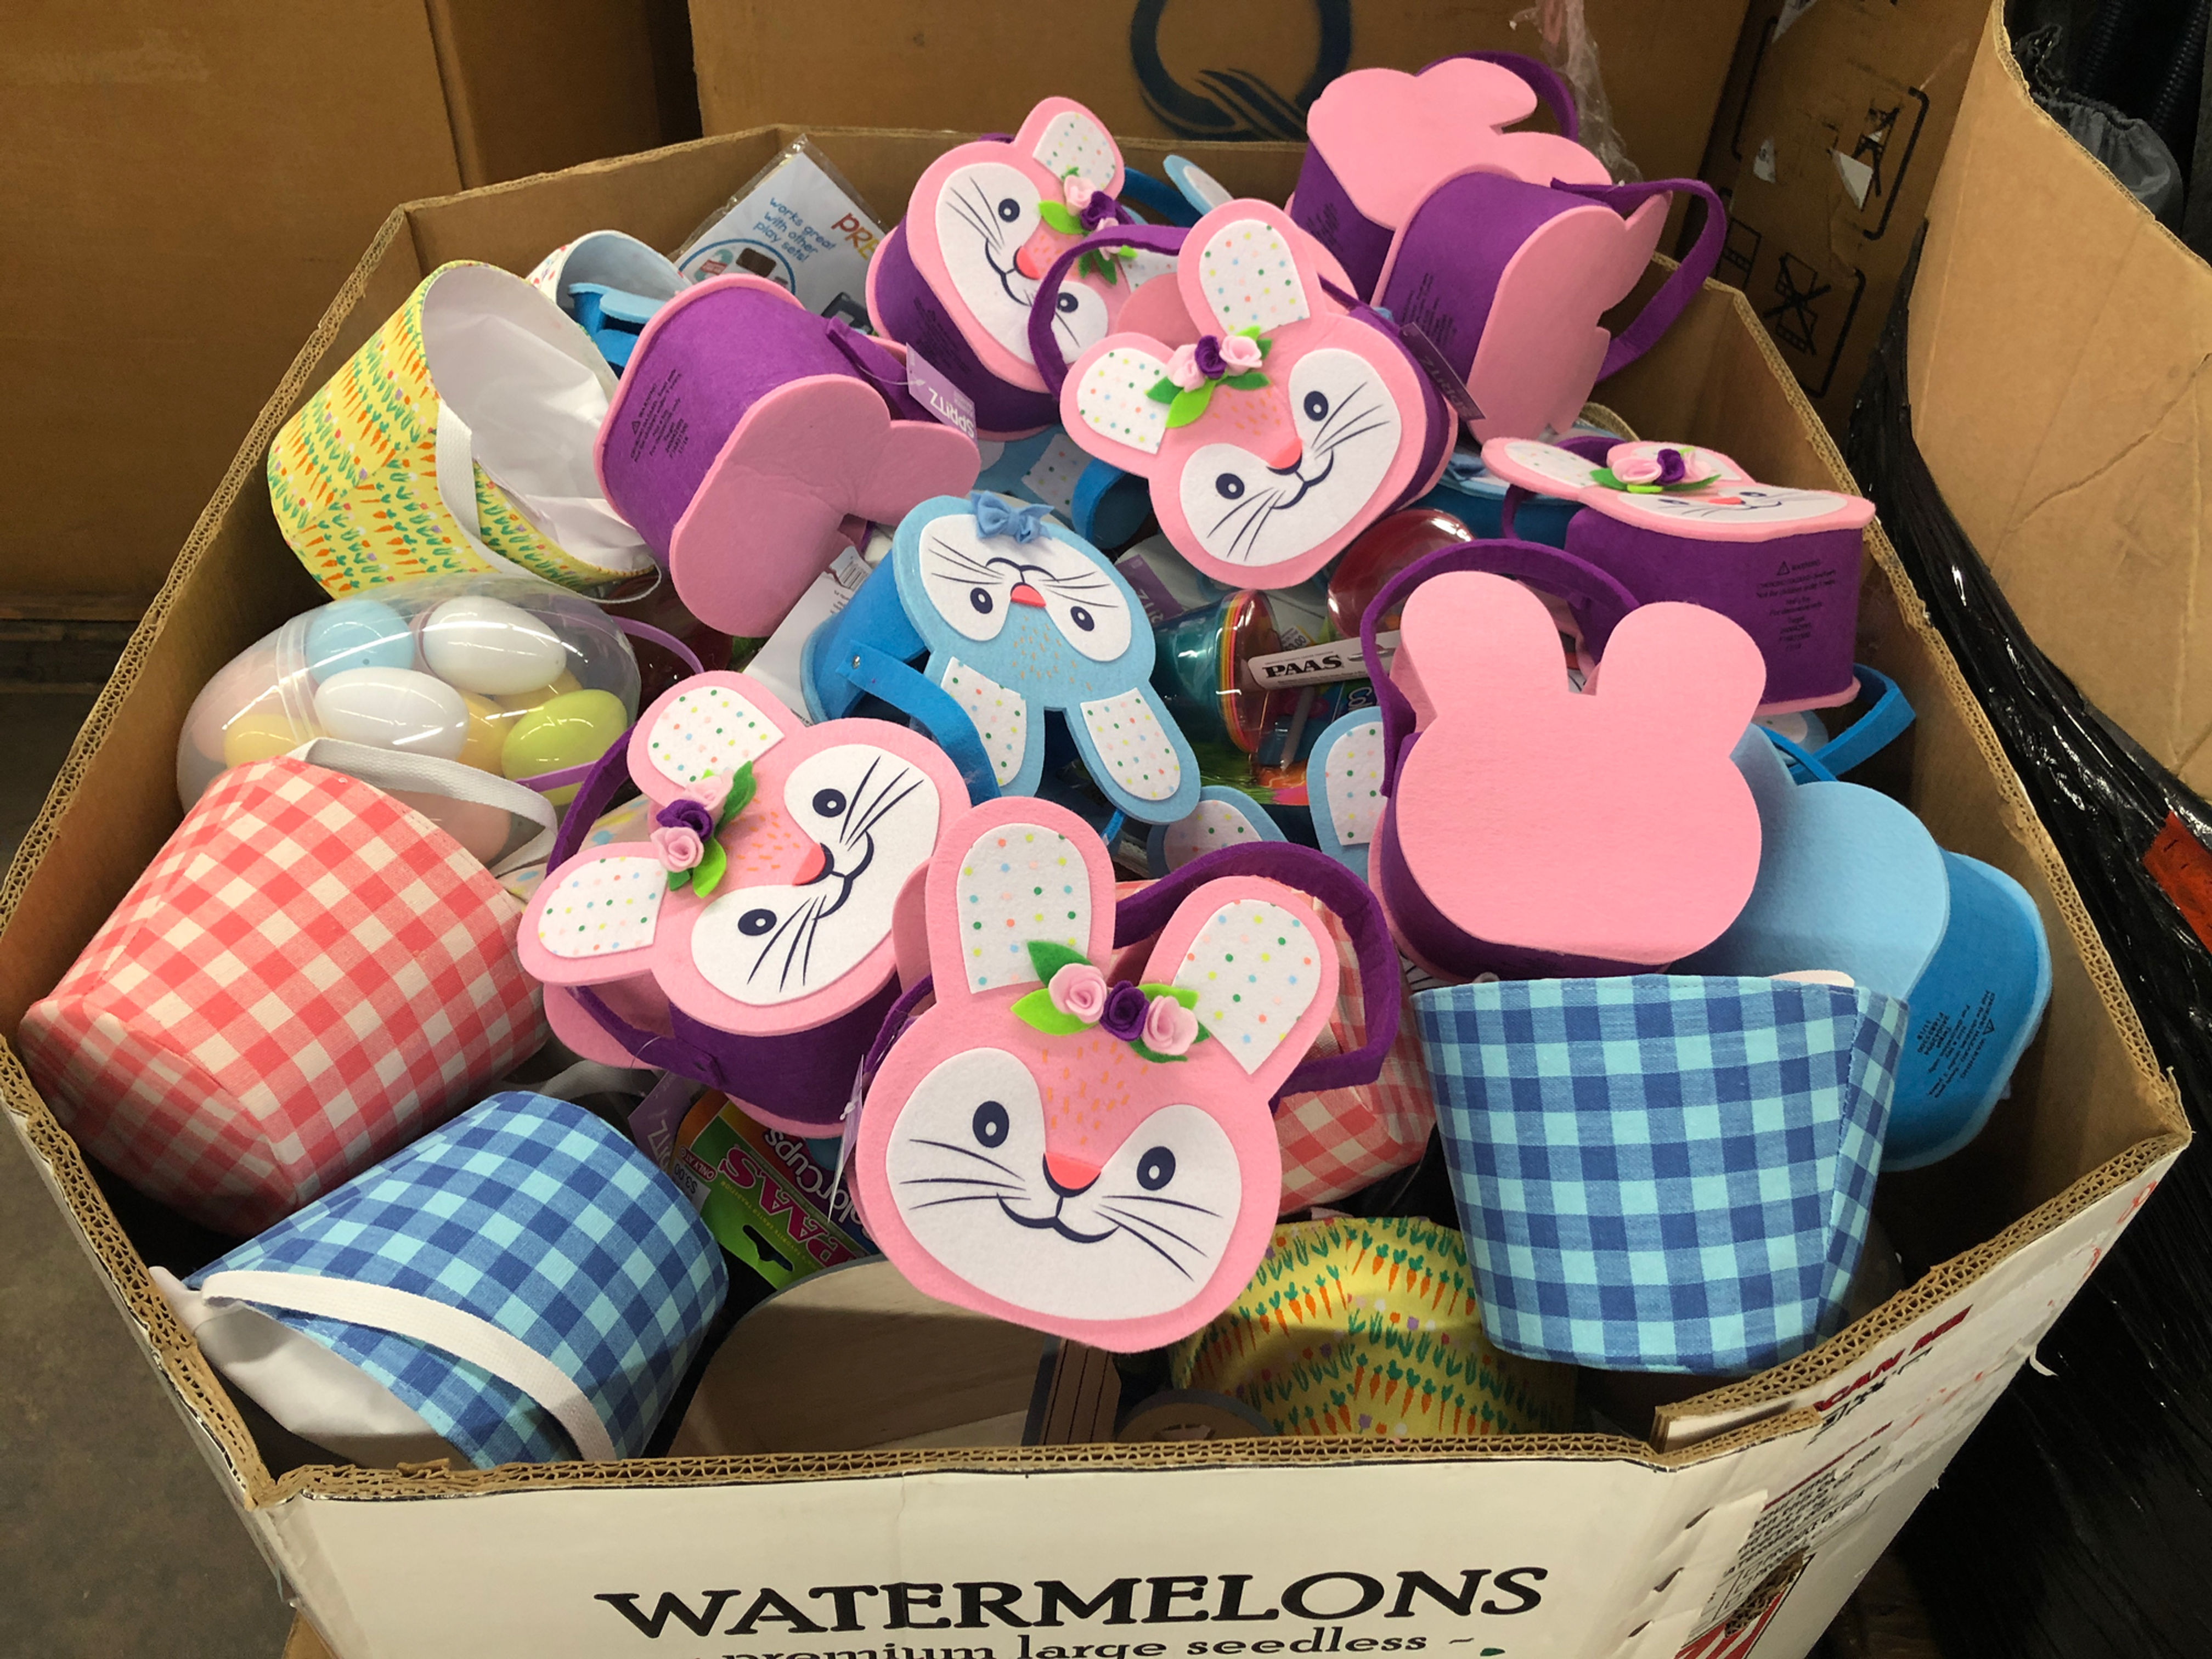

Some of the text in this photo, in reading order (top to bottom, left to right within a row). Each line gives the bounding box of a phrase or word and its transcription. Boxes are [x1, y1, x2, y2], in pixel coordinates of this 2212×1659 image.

[752, 221, 809, 263] play sets!
[764, 211, 819, 254] with other
[770, 197, 836, 251] works great
[928, 386, 975, 438] SPRITZ
[1262, 654, 1343, 678] PAAS
[675, 1163, 698, 1194] $3.00
[685, 1153, 714, 1180] ONLY AT
[764, 1128, 873, 1241] olorCups
[718, 1146, 858, 1267] PAAS
[594, 1567, 1548, 1638] WATERMELONS
[723, 1626, 1427, 1659] premium large seedless
